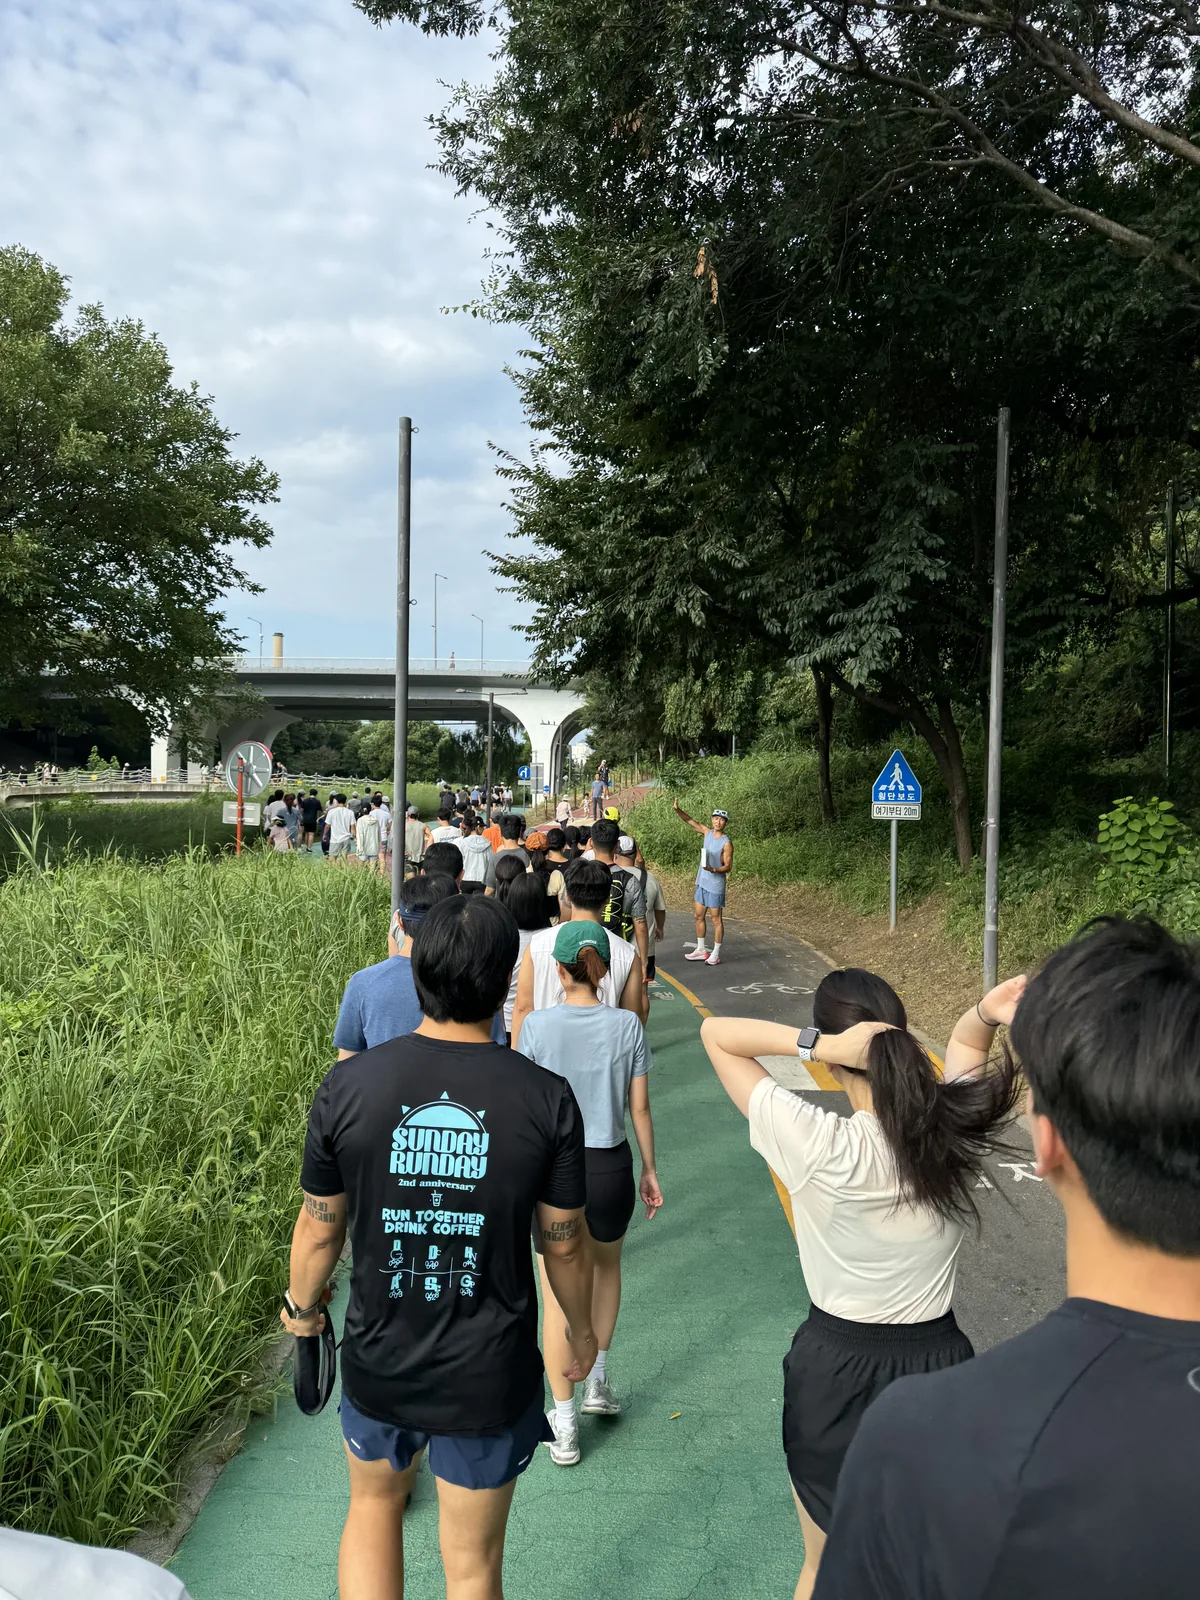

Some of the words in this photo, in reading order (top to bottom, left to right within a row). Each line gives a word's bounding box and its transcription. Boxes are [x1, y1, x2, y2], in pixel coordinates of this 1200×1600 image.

[878, 792, 915, 800] 횡단보도
[875, 806, 902, 816] 여기부터
[903, 807, 918, 816] 20m
[391, 1127, 489, 1156] SUNDAY
[389, 1150, 488, 1179] RUNDAY
[398, 1178, 416, 1187] 2nd
[419, 1180, 476, 1192] anniversary
[382, 1208, 410, 1221] RUN
[415, 1209, 485, 1226] TOGETHER
[384, 1221, 428, 1235] DRINK
[432, 1222, 480, 1237] COFFEE
